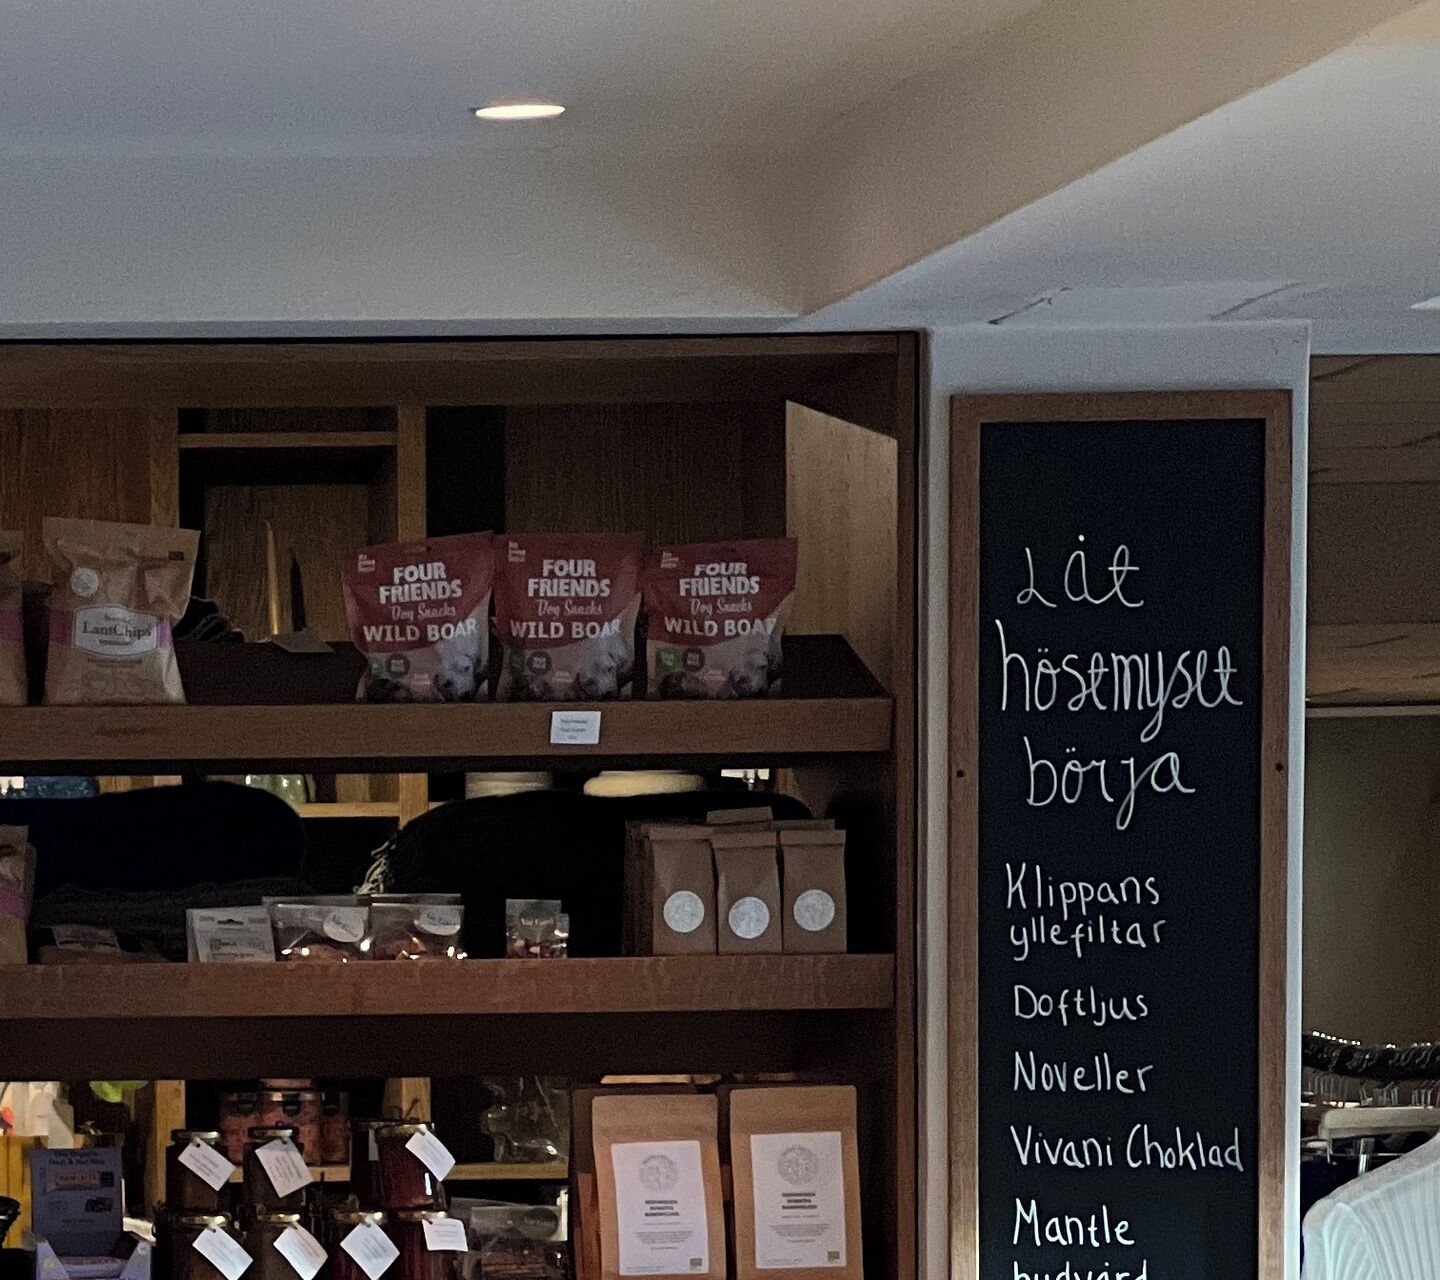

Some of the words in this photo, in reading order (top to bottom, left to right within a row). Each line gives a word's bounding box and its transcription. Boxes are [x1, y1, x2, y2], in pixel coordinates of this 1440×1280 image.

[393, 562, 447, 584] FOUR
[542, 559, 596, 577] FOUR
[694, 562, 748, 576] FOUR
[1016, 533, 1145, 608] Låt
[379, 579, 463, 604] FRIENDS
[528, 578, 611, 597] FRIENDS
[679, 576, 760, 596] FRIENDS
[363, 625, 420, 642] WILD
[427, 618, 477, 642] BOAR
[510, 619, 565, 639] WILD
[664, 616, 718, 637] WILD
[995, 618, 1244, 743] höstmyset
[1023, 735, 1196, 831] börja
[1006, 862, 1161, 921] Klippans
[1010, 916, 1167, 961] yllefiltar
[1013, 984, 1149, 1027] Doftljus
[1013, 1051, 1154, 1094] Noveller
[1010, 1124, 1113, 1169] Vivani
[1126, 1123, 1244, 1172] Choklad
[1013, 1197, 1136, 1248] Mantle
